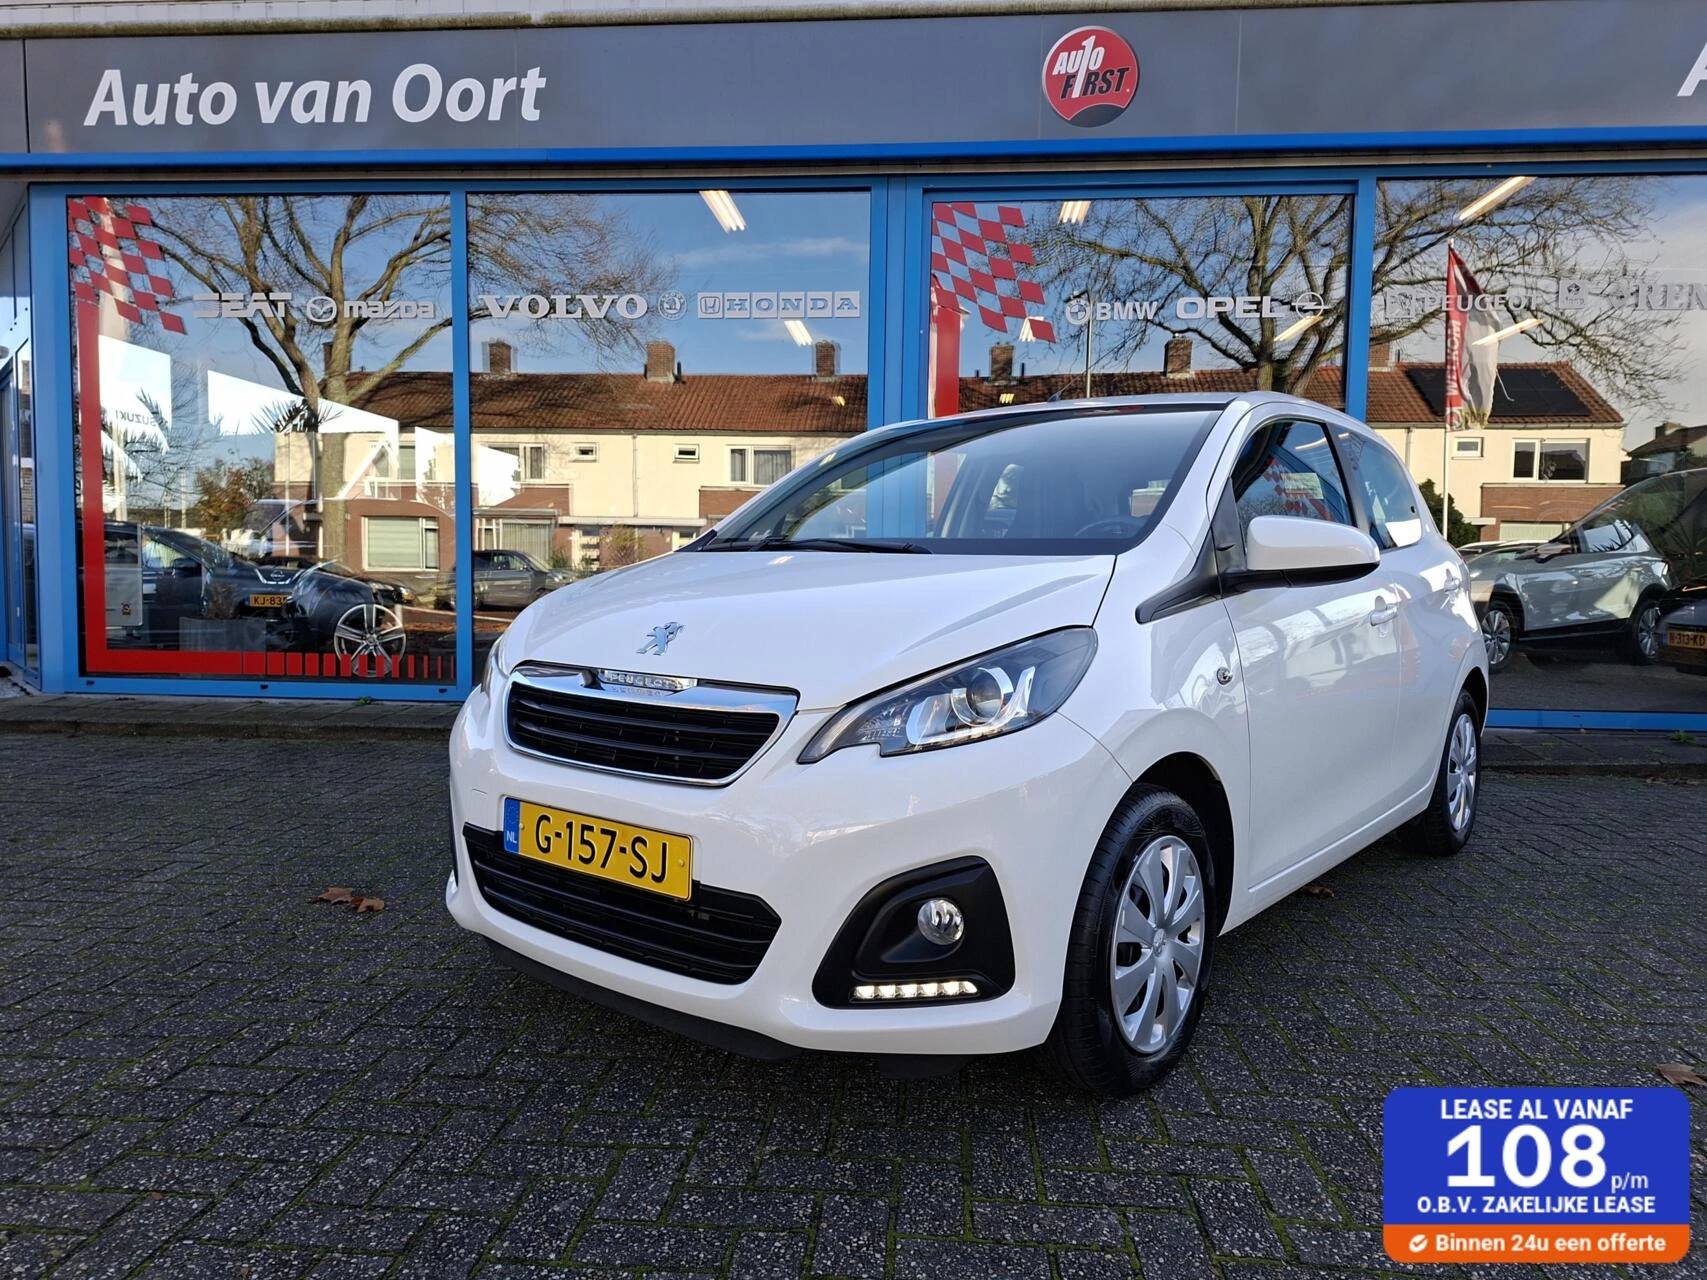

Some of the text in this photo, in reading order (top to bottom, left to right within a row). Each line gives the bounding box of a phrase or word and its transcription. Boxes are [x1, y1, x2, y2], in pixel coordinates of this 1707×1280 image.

[83, 63, 547, 126] Auto van Oort
[192, 292, 292, 318] SEAT
[343, 300, 435, 319] mazda
[480, 294, 648, 319] VOLVO
[726, 292, 860, 319] HONDA
[1096, 301, 1158, 321] BMW
[1176, 296, 1286, 320] OPEL
[1424, 294, 1540, 312] PEUGEOT
[610, 673, 678, 691] PEUGEOT
[506, 830, 518, 845] NL
[535, 814, 669, 884] G-157-SJ
